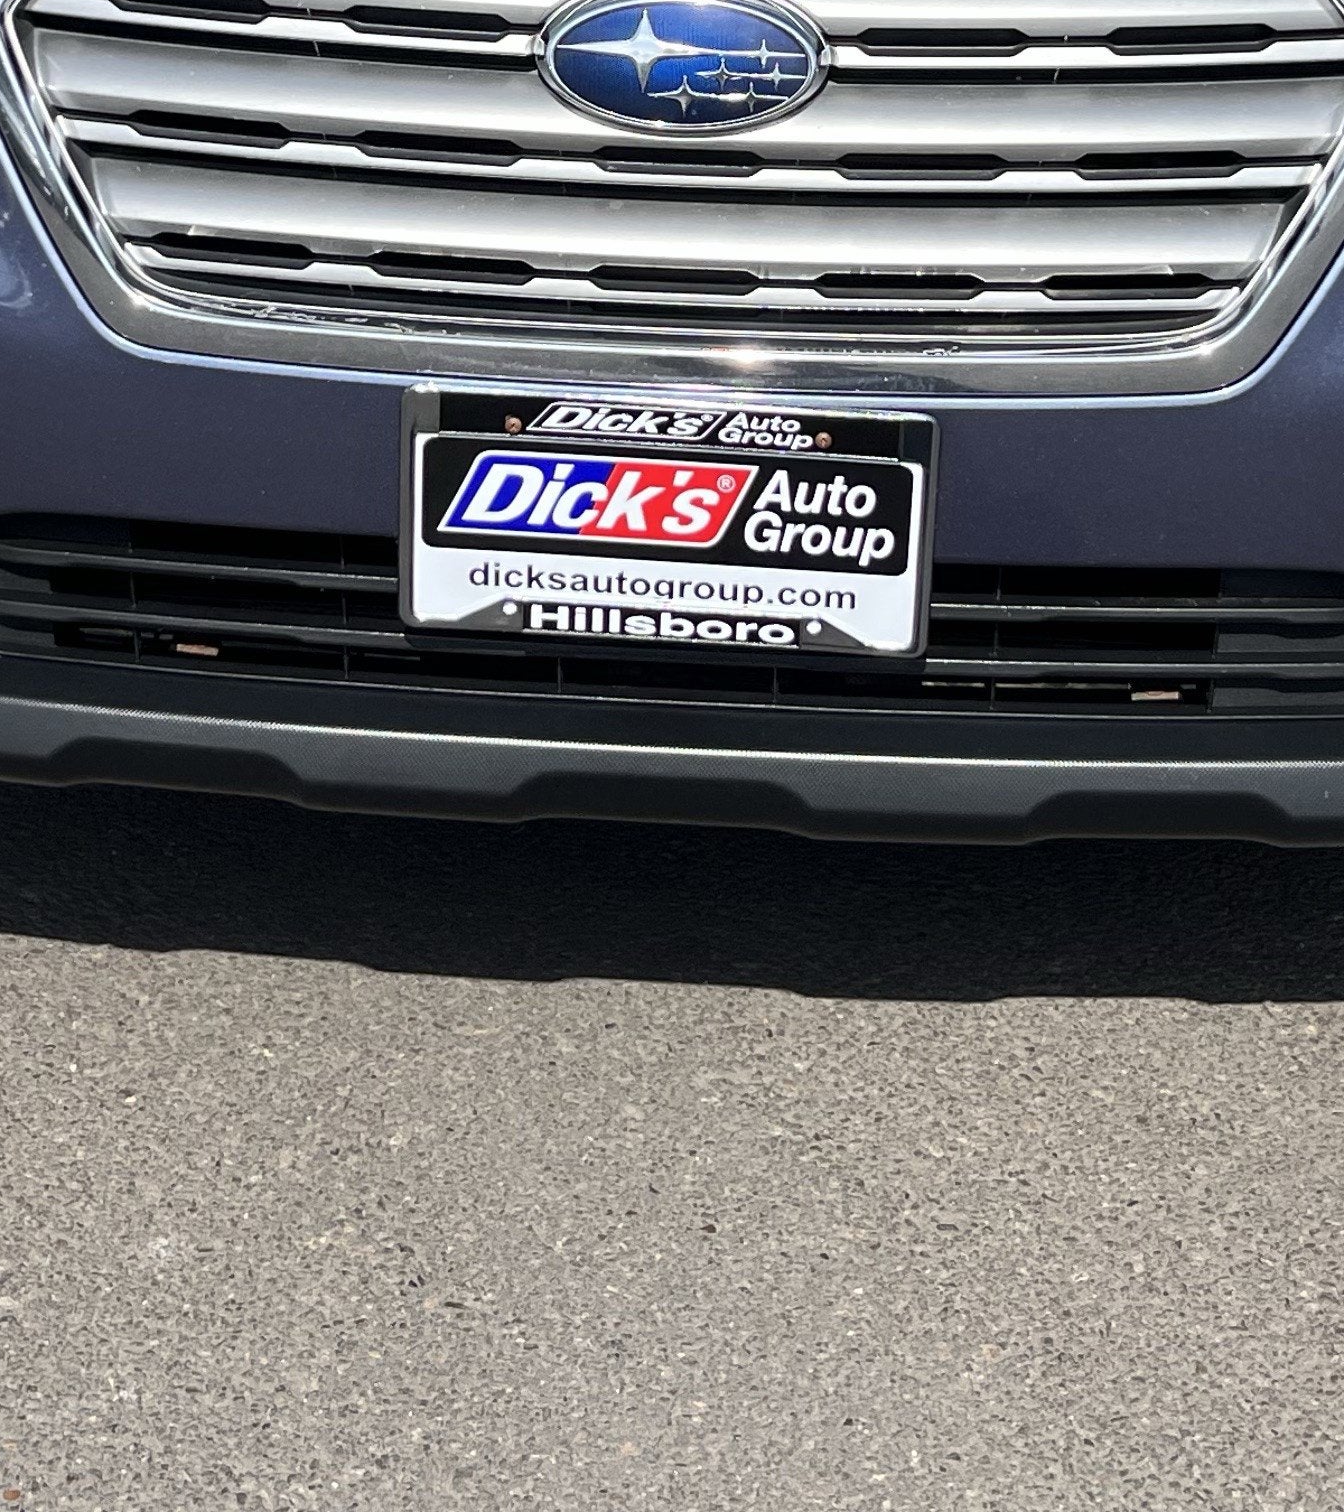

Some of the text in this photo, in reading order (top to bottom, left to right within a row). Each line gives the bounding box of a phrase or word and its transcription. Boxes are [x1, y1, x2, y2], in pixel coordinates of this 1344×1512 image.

[717, 428, 814, 451] Group
[724, 411, 802, 433] Auto
[460, 463, 721, 536] Dick's
[753, 469, 878, 518] Auto
[744, 510, 896, 567] Group
[468, 561, 858, 611] dicksautogroup.com
[528, 602, 796, 645] Hillsboro
